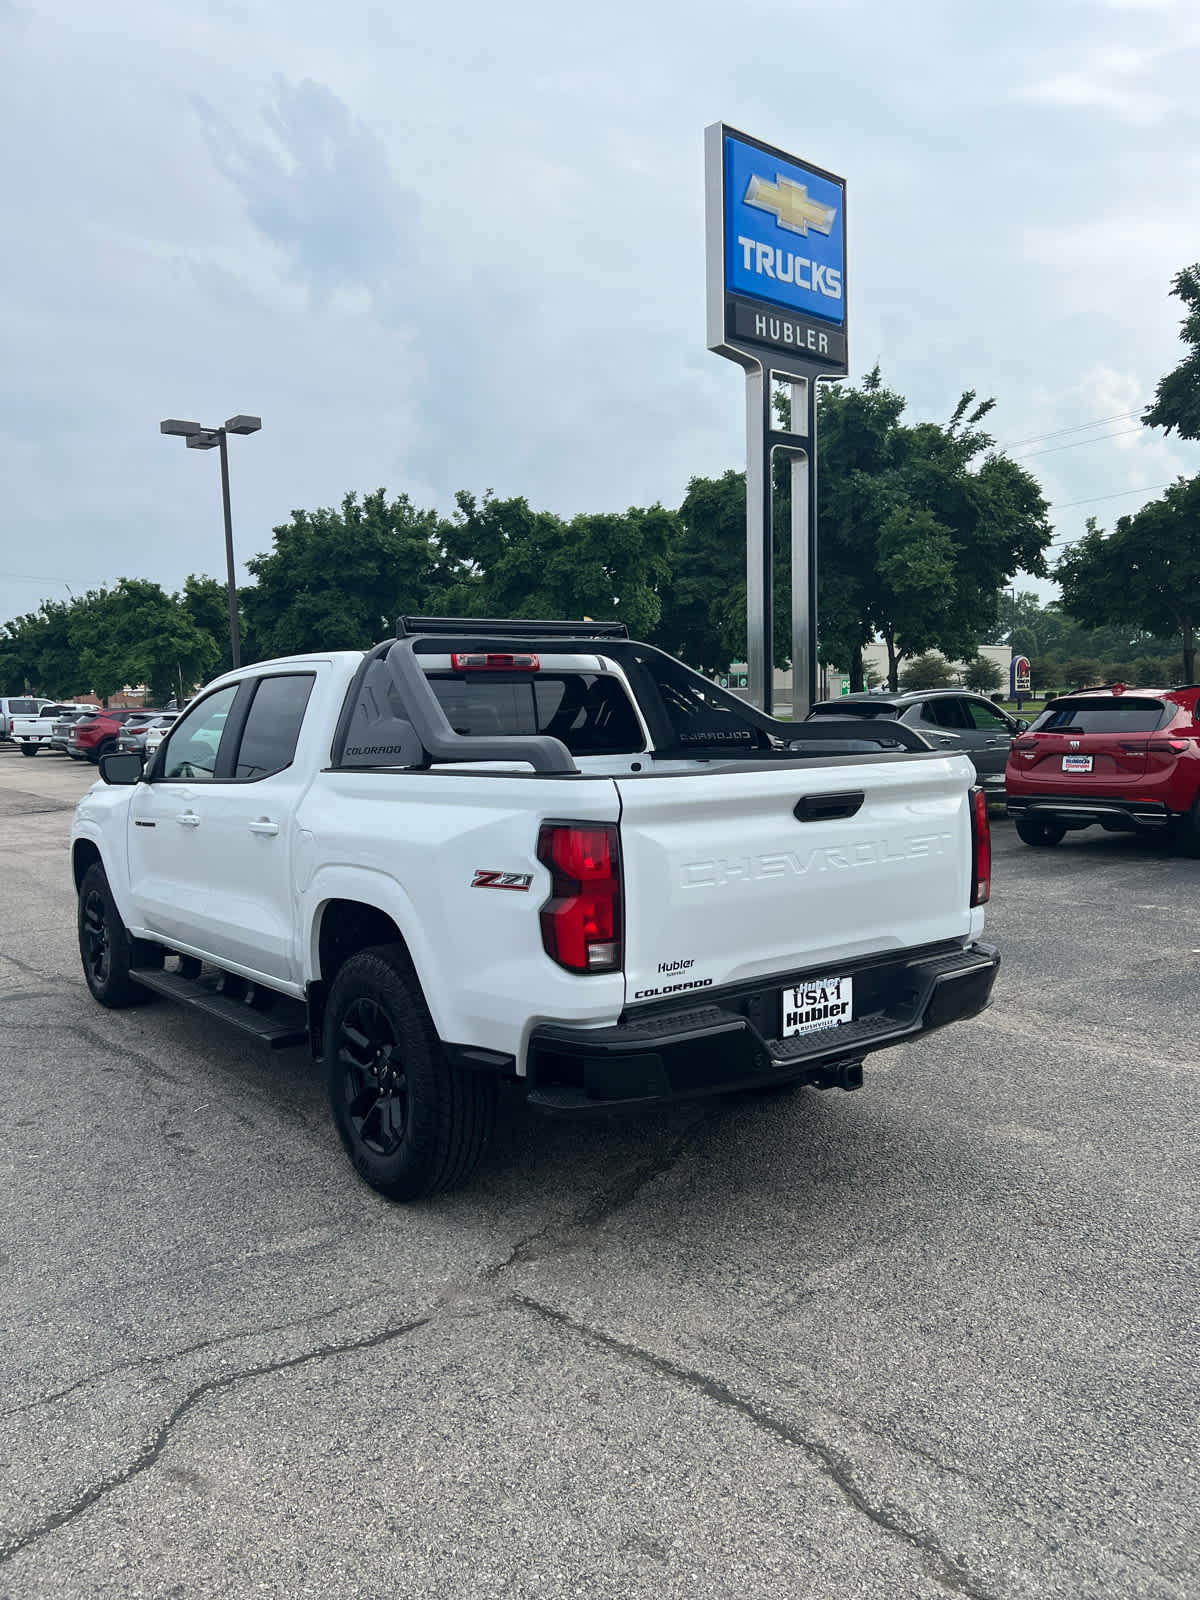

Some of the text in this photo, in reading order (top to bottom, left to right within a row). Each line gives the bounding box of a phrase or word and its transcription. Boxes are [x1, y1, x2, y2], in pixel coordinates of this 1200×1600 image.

[738, 235, 842, 299] TRUCKS
[755, 314, 829, 354] HUBLER
[345, 745, 402, 756] COLORADO
[680, 832, 952, 888] CHEVROLET
[471, 869, 534, 892] Z71
[657, 959, 695, 973] Hubler
[634, 978, 713, 999] COLORADO
[794, 985, 841, 1009] USA-1
[786, 1001, 849, 1028] Hubler
[800, 1019, 833, 1031] RUSHVILLE
